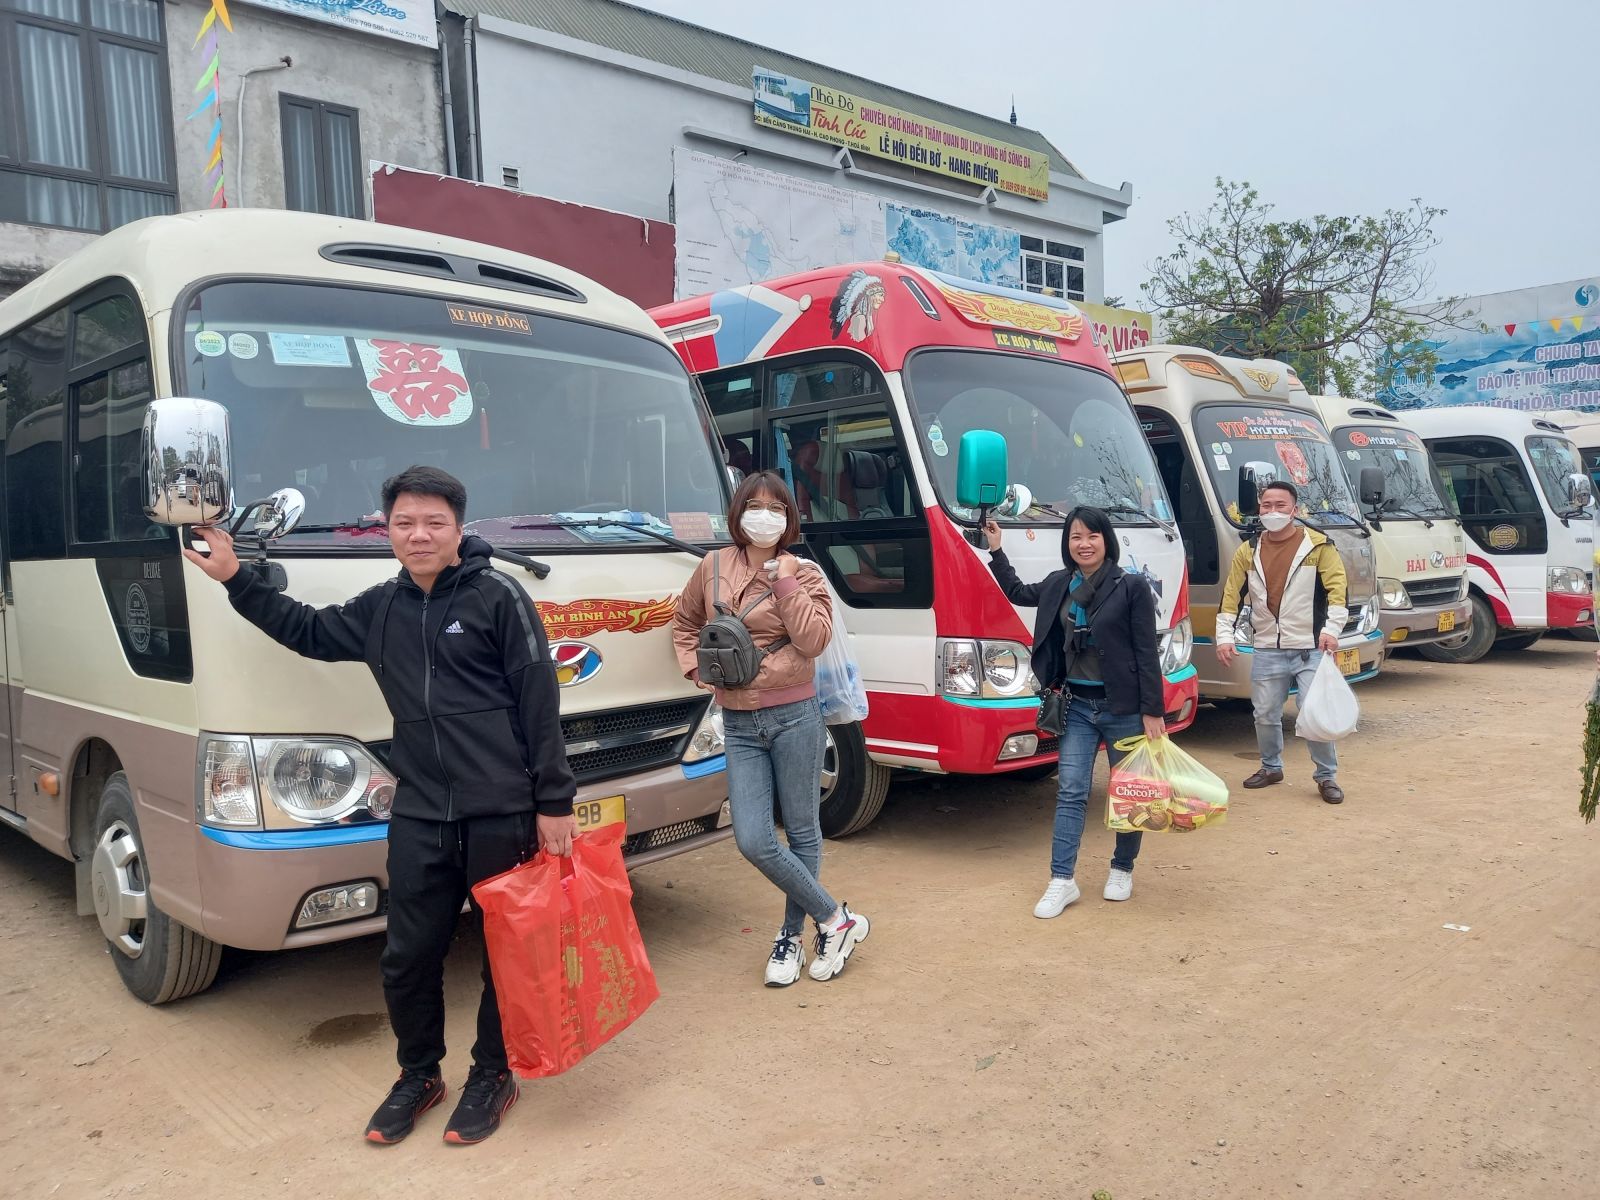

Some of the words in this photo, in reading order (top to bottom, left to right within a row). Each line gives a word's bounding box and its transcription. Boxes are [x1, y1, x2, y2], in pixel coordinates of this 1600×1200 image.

[810, 86, 834, 105] Nhà
[838, 94, 855, 111] Đò
[844, 118, 867, 140] Cúc
[902, 119, 924, 138] KHÁCH
[942, 132, 960, 149] QUAN
[960, 137, 969, 151] DU
[969, 139, 983, 157] LỊCH
[880, 131, 890, 154] LỄ
[892, 138, 908, 161] HỘI
[909, 141, 927, 164] ĐỀN
[929, 148, 942, 168] BỜ
[949, 156, 971, 177] HANG
[973, 162, 999, 184] MIẾNG
[449, 308, 465, 321] XE
[467, 311, 493, 328] HỢP
[494, 312, 529, 331] ĐỒNG
[994, 333, 1011, 346] XE
[1010, 334, 1031, 351] HỢP
[1535, 342, 1581, 363] CHUNG
[1478, 371, 1502, 391] BẢO
[1505, 369, 1521, 390] VỆ
[1524, 367, 1550, 386] MÔI
[1216, 421, 1248, 438] VIP
[1406, 553, 1427, 573] HẢI
[569, 611, 604, 622] BÌNH
[607, 610, 627, 620] AN
